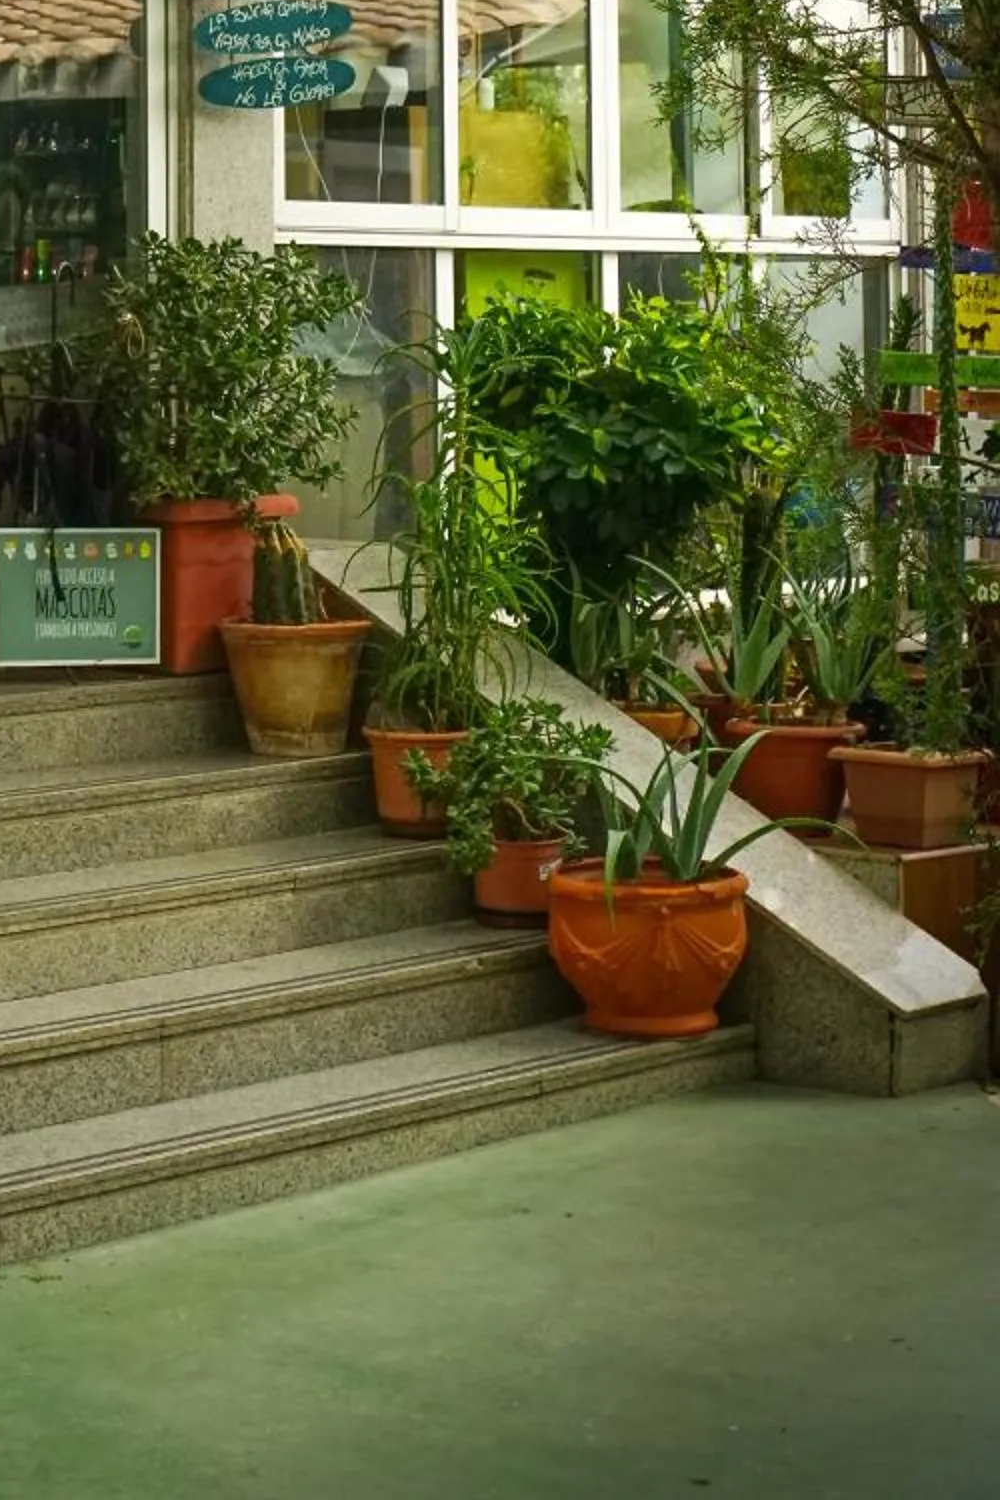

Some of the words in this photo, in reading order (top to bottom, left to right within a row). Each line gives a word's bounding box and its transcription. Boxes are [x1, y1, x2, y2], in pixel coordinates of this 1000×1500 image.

[208, 13, 229, 35] LA
[293, 23, 332, 47] MUNDO
[231, 60, 273, 82] HACER
[293, 57, 329, 81] AMOR
[233, 85, 257, 107] NO
[263, 90, 283, 107] LA
[289, 82, 335, 104] GUERRA
[35, 586, 118, 620] MASCOTAS
